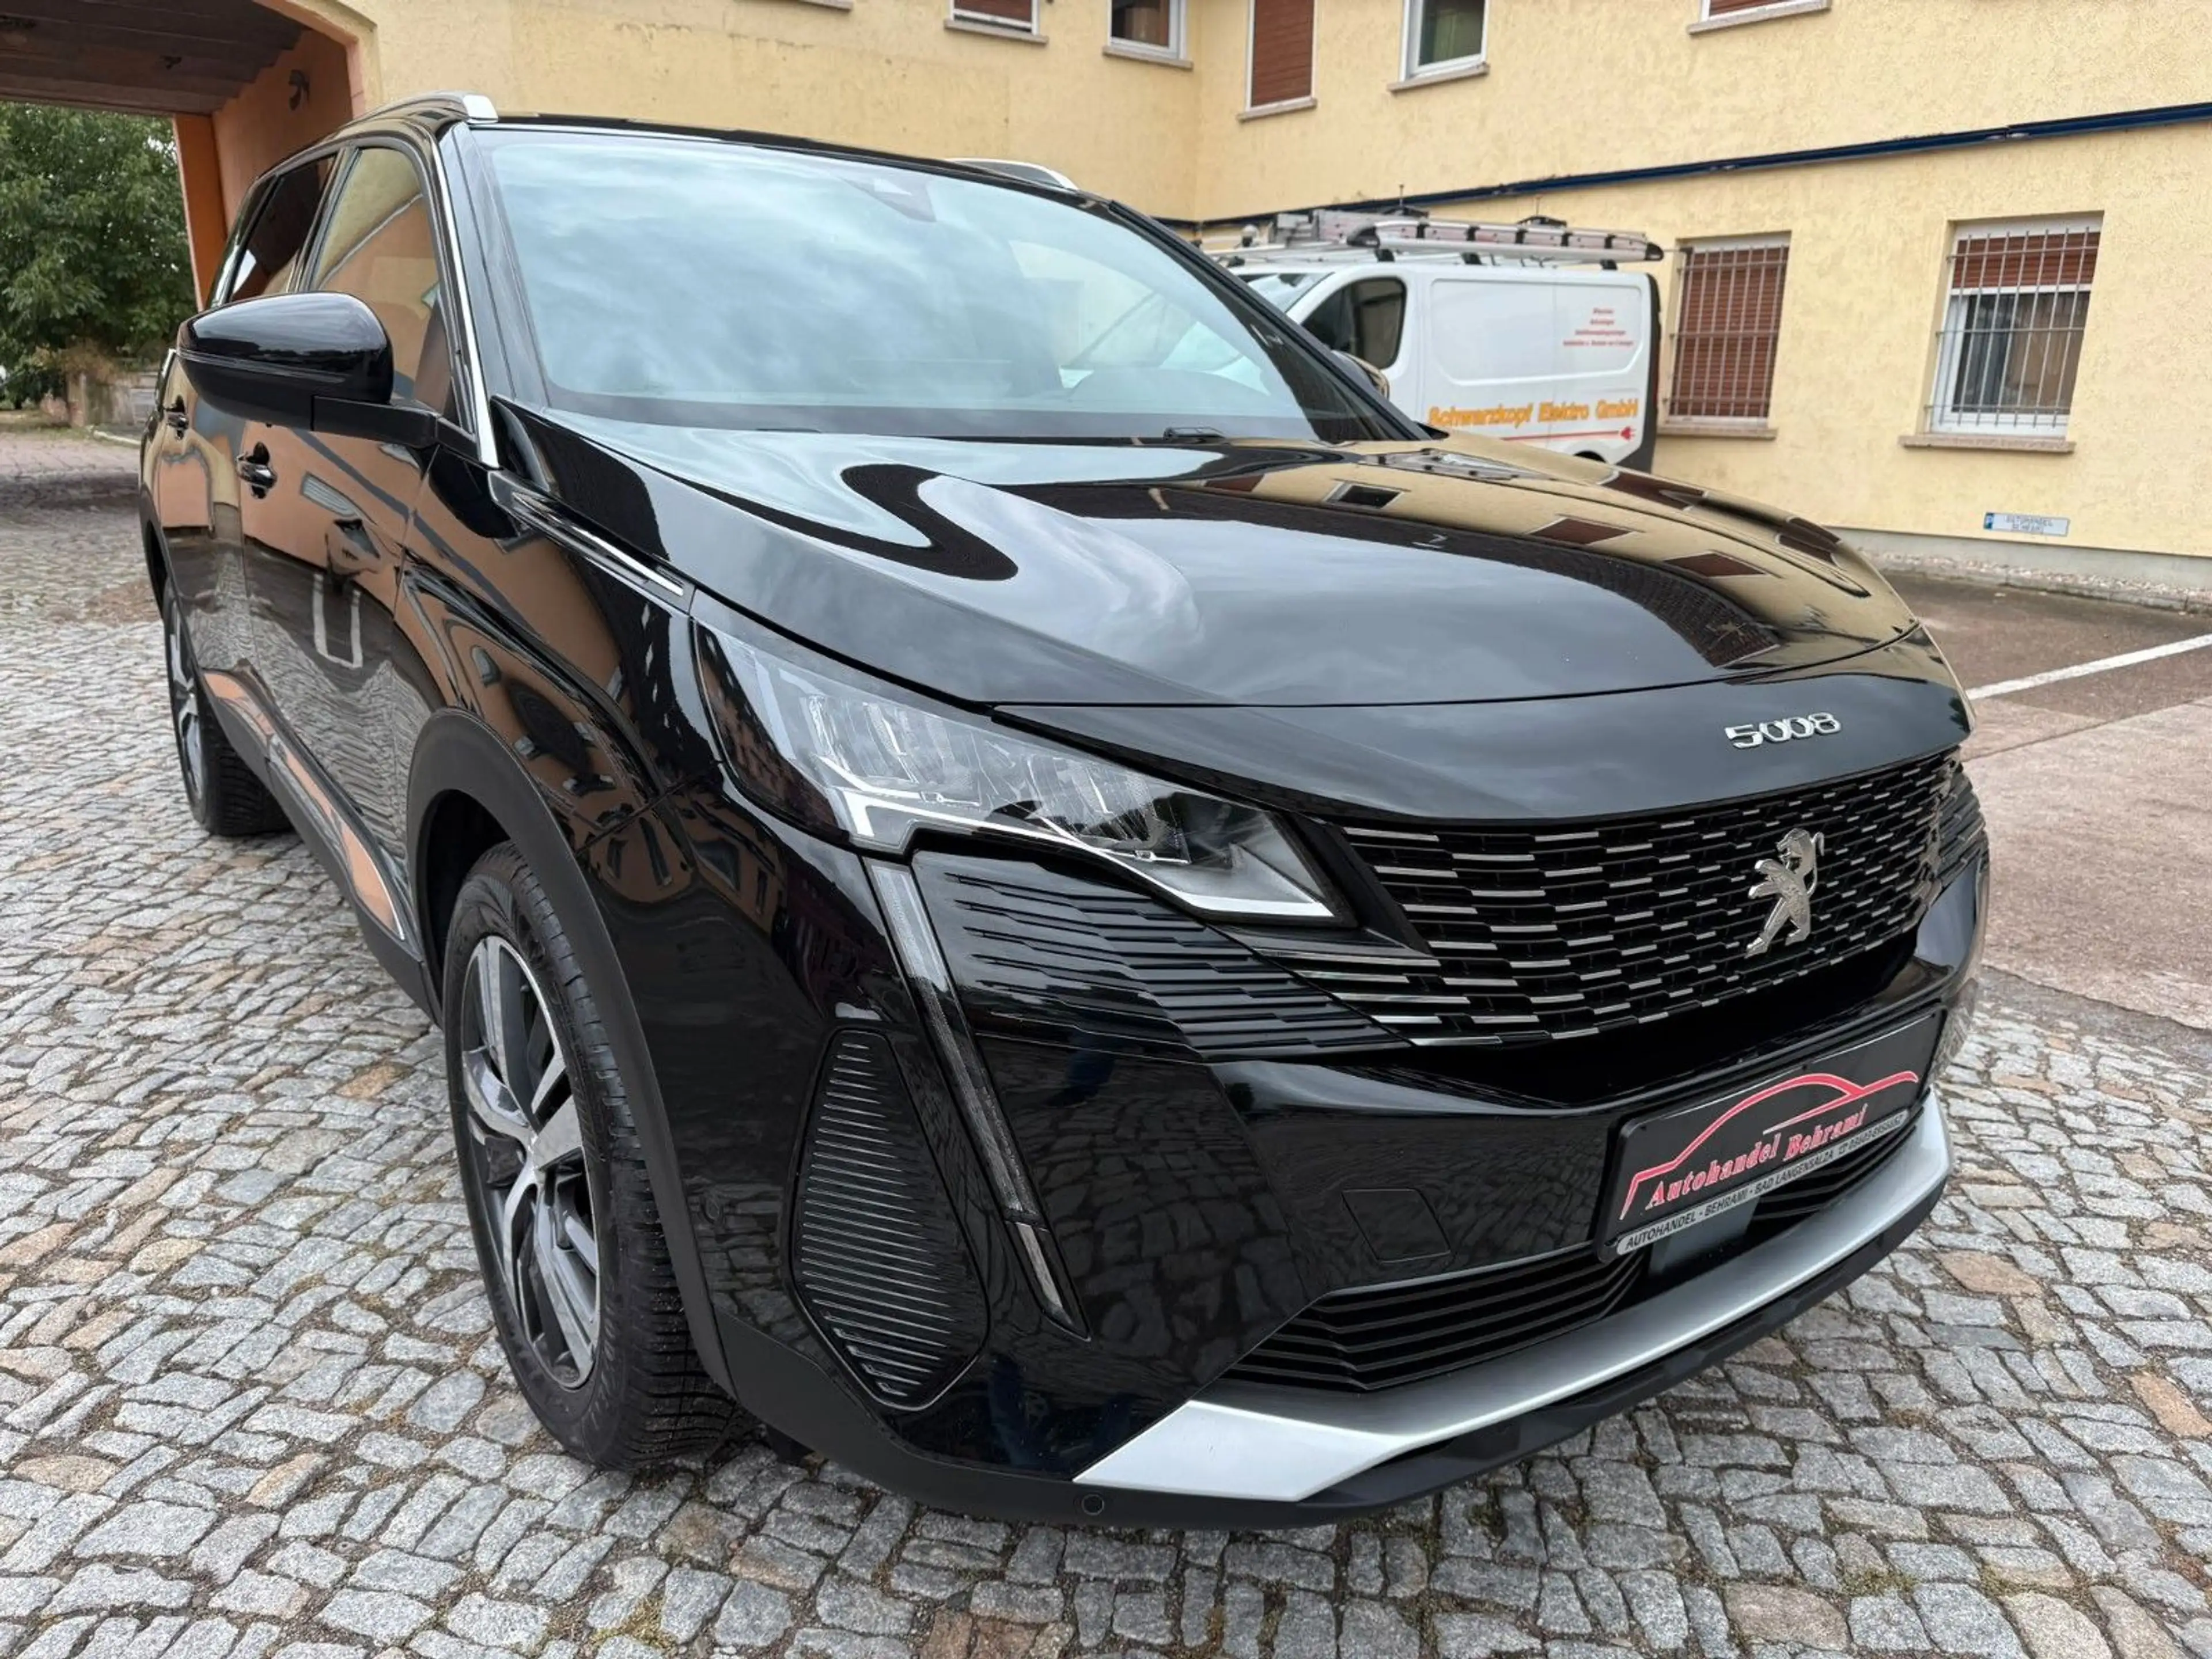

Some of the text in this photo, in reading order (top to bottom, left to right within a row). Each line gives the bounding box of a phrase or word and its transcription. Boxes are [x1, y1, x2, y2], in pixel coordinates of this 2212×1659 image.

[1594, 397, 1638, 420] GmbH
[1724, 712, 1841, 749] 5008
[1645, 1132, 1782, 1210] Autohandel
[1783, 1103, 1869, 1162] Behrami
[1626, 1213, 1696, 1250] AUTOHANDEL
[1705, 1185, 1748, 1215] BEHRAMI
